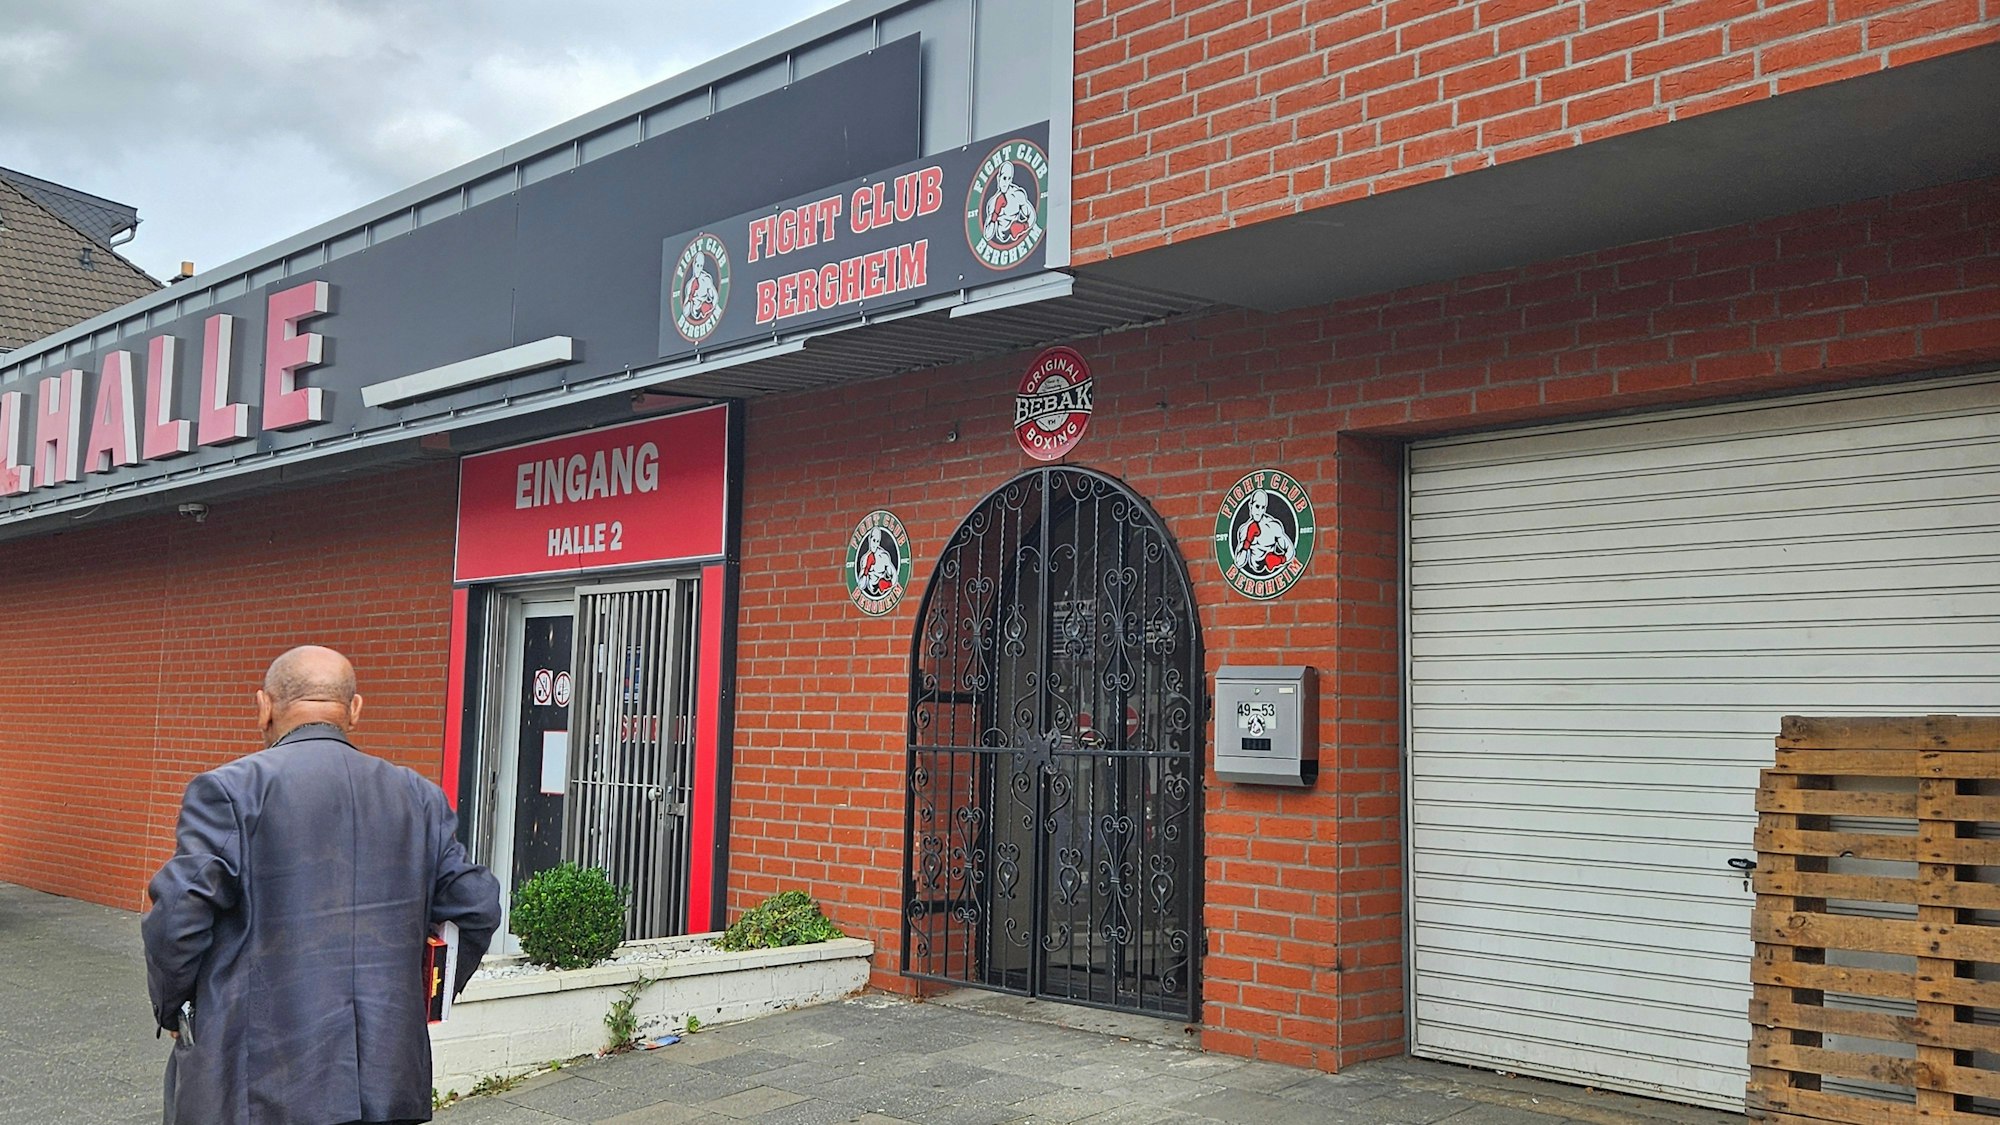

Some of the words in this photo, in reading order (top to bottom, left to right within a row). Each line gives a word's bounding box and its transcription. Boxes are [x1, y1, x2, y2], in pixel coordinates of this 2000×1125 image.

[973, 145, 1012, 194] FIGHT
[1016, 143, 1048, 179] CLUB
[747, 194, 842, 264] FIGHT
[850, 165, 944, 235] CLUB
[676, 238, 704, 277] FIGHT
[706, 237, 727, 268] CLUB
[975, 223, 1043, 266] BERGHEIM
[755, 238, 929, 325] BERGHEIM
[677, 304, 722, 338] BERGHEIM
[1027, 358, 1079, 393] ORIGINAL
[1015, 380, 1093, 425] BEBAK
[1026, 421, 1077, 450] BOXING
[515, 441, 660, 510] EINGANG
[1221, 473, 1265, 519] FIGHT
[1270, 473, 1308, 513] CLUB
[547, 522, 607, 557] HALLE
[610, 520, 623, 551] 2
[1225, 556, 1303, 596] BERGHEIM
[1237, 703, 1275, 717] 49-53
